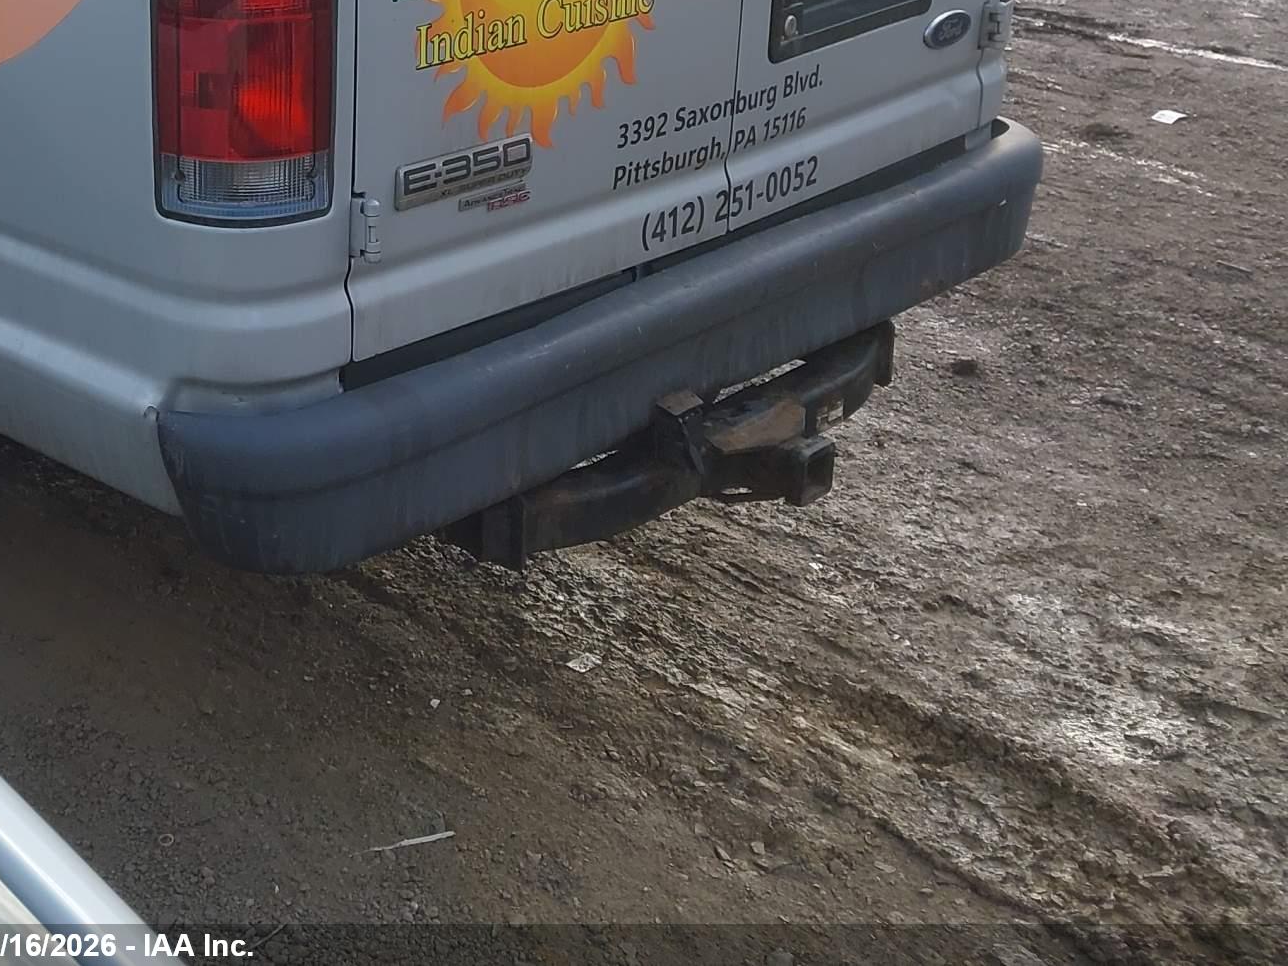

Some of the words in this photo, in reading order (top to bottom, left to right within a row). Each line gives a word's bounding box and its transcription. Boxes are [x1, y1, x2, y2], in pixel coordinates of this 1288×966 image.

[415, 10, 528, 70] Indian
[612, 135, 727, 191] Pittsburgh,
[732, 125, 756, 153] PA
[762, 106, 807, 142] 15116
[617, 111, 669, 149] 3392
[673, 88, 778, 132] Saxonburg
[782, 63, 823, 99] Blvd.
[404, 137, 531, 195] E-350
[641, 195, 705, 251] (412)
[714, 154, 818, 223] 251-0052
